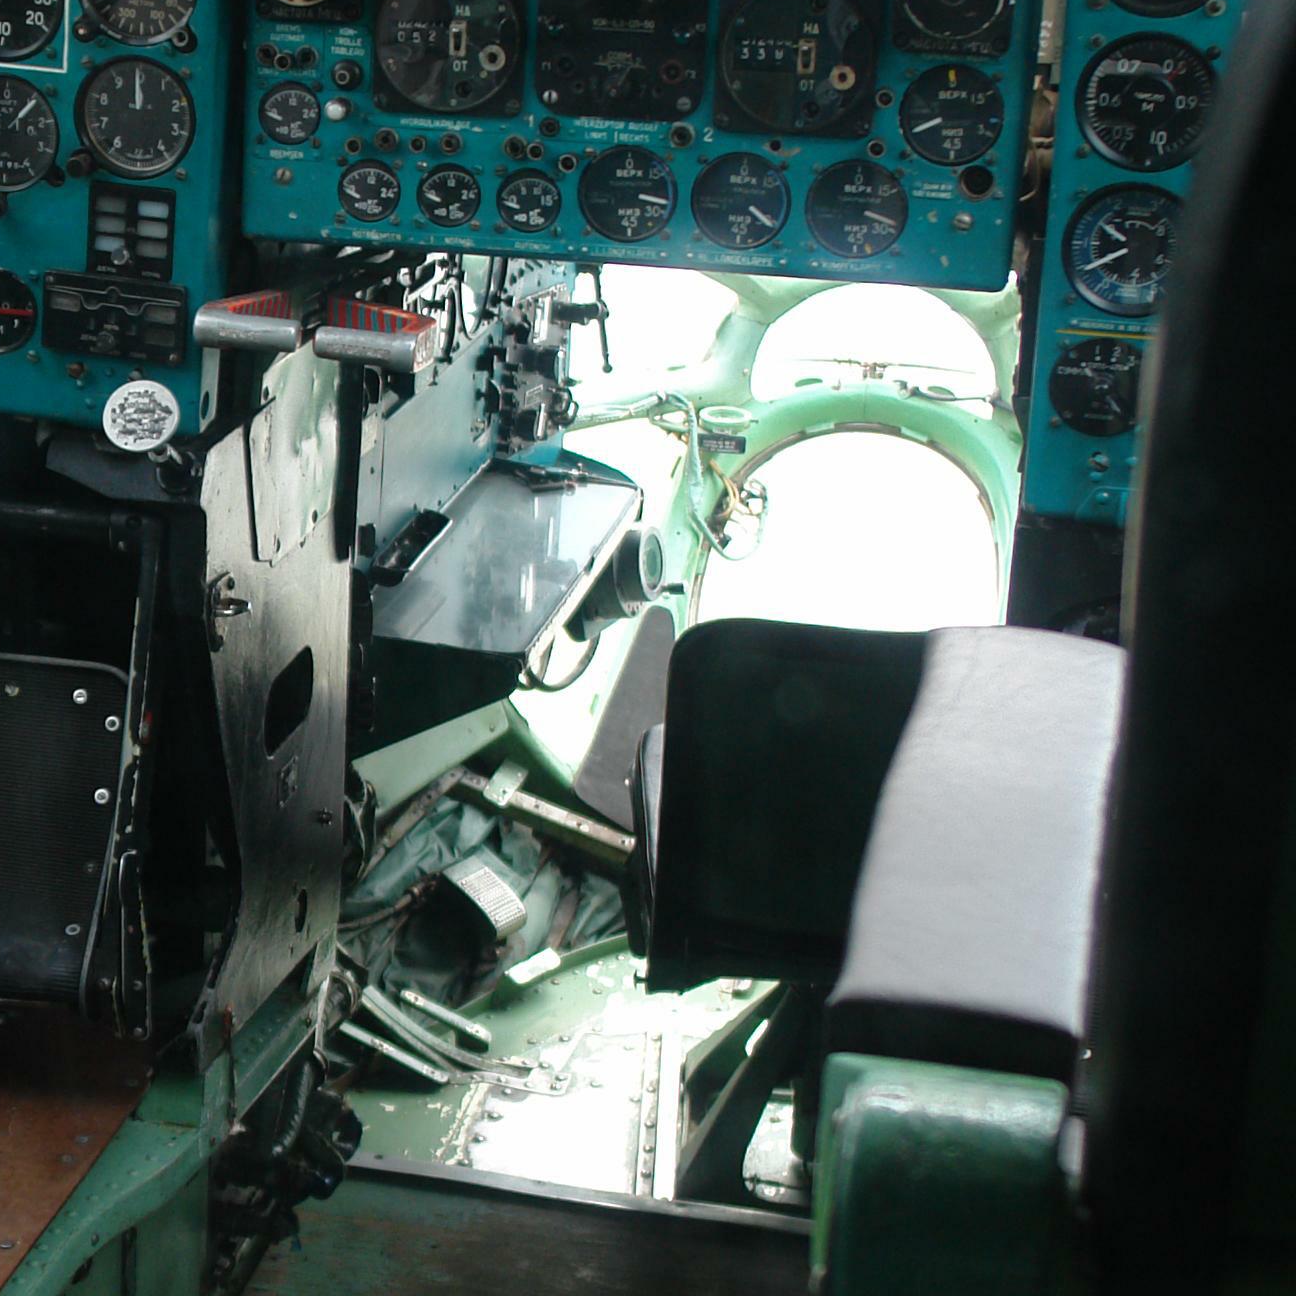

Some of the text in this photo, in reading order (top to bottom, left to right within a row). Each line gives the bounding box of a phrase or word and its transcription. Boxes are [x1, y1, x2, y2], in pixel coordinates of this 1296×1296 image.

[118, 8, 136, 18] 300
[150, 10, 165, 20] 100
[455, 5, 471, 17] НА
[26, 10, 44, 25] 20
[803, 22, 820, 34] НА
[452, 60, 468, 72] ОТ
[115, 76, 123, 89] 9
[161, 78, 165, 91] 1
[799, 79, 816, 91] ОТ
[3, 89, 11, 99] 0
[99, 93, 108, 105] 8
[937, 90, 968, 100] ВЕРХ
[970, 93, 985, 104] 15
[171, 100, 180, 113] 2
[37, 117, 45, 128] 2
[99, 116, 109, 129] 7
[171, 123, 179, 136] 3
[941, 128, 964, 137] НИЗ
[703, 128, 714, 143] 2
[37, 141, 44, 152] 3
[113, 136, 122, 148] 6
[157, 139, 165, 151] 4
[943, 137, 962, 150] 45
[625, 158, 634, 169] 0
[616, 169, 643, 178] ВЕРХ
[649, 168, 661, 180] 15
[740, 165, 749, 176] 0
[730, 176, 758, 185] ВЕРХ
[855, 174, 864, 185] 0
[380, 188, 394, 198] 24
[843, 184, 873, 194] ВЕРХ
[878, 185, 891, 197] 15
[461, 190, 475, 200] 24
[541, 195, 553, 206] 15
[618, 208, 641, 217] НИЗ
[644, 207, 661, 217] 30
[621, 217, 638, 228] 45
[728, 214, 752, 224] НИЗ
[730, 225, 748, 235] 45
[843, 224, 868, 234] НИЗ
[871, 223, 889, 235] 30
[847, 234, 865, 245] 45
